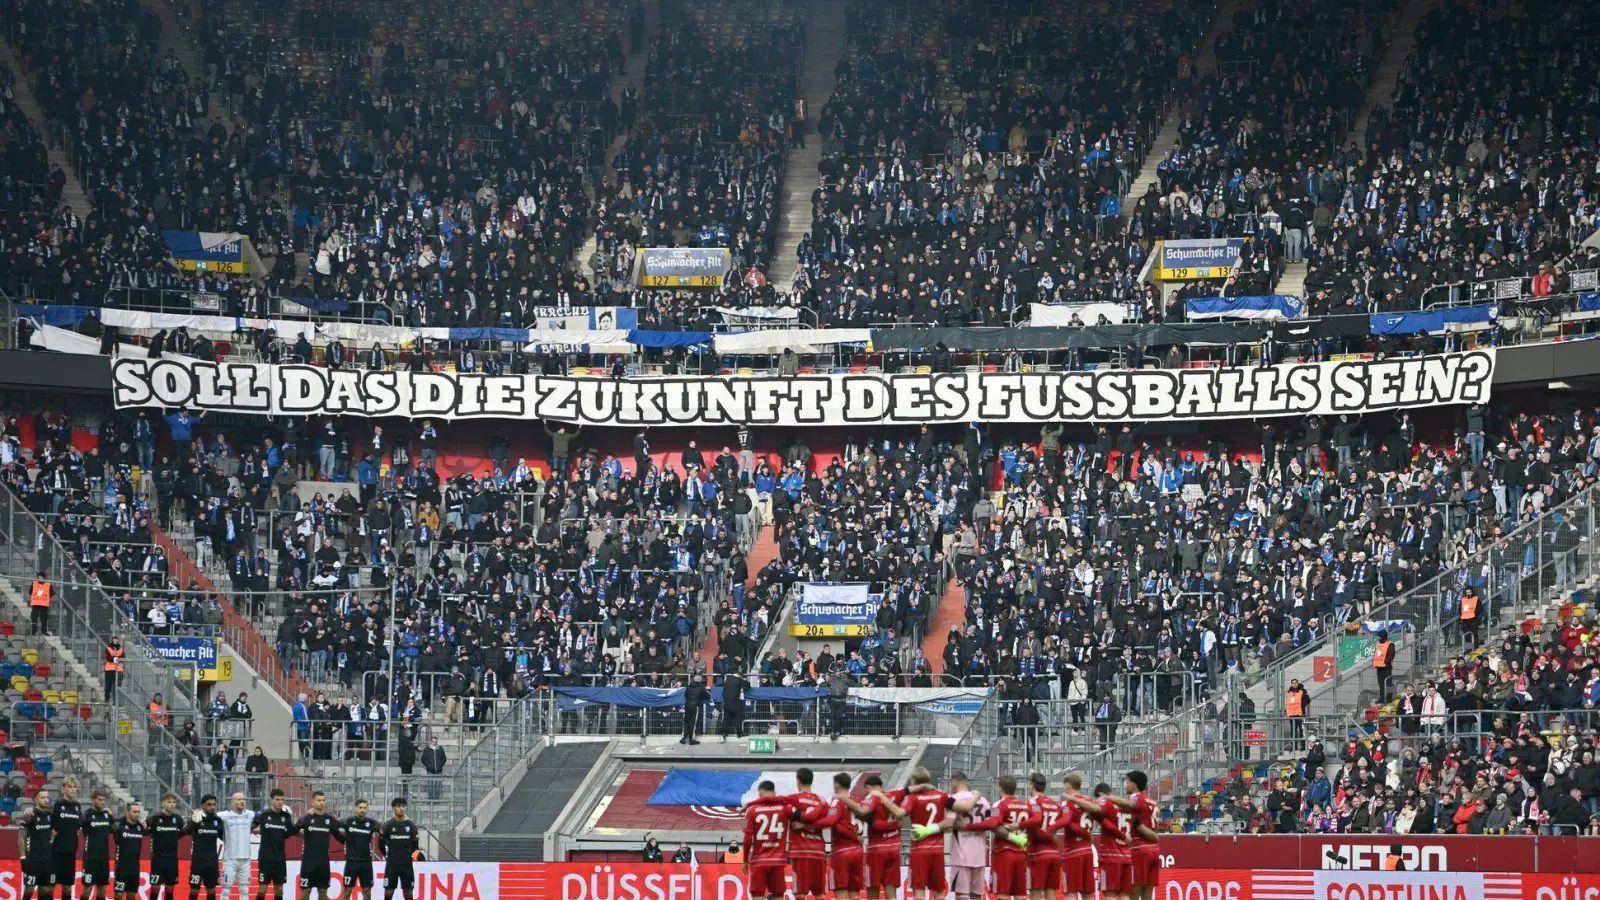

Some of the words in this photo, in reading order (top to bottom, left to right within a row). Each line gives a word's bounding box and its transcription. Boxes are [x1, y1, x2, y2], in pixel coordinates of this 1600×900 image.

[225, 243, 239, 254] Alt
[1166, 247, 1224, 260] Schumacher
[216, 262, 233, 272] 126
[1171, 268, 1187, 278] 129
[652, 276, 669, 285] 127
[700, 276, 717, 285] 128
[113, 359, 270, 411] SOLL
[279, 365, 397, 416] DAS
[409, 371, 524, 419] DIE
[536, 375, 833, 424] ZUKUNFT
[842, 372, 969, 422] DES
[978, 365, 1321, 420] FUSSBALLS
[1331, 352, 1492, 410] SEIN?
[800, 603, 864, 616] Schumacher
[805, 625, 817, 636] 20
[198, 646, 214, 660] Alt
[223, 660, 232, 677] 19
[1323, 661, 1331, 678] 2
[755, 813, 784, 840] 24
[151, 875, 159, 884] 27
[190, 875, 200, 884] 29
[300, 878, 308, 887] 22
[344, 876, 352, 885] 17
[115, 881, 125, 891] 23
